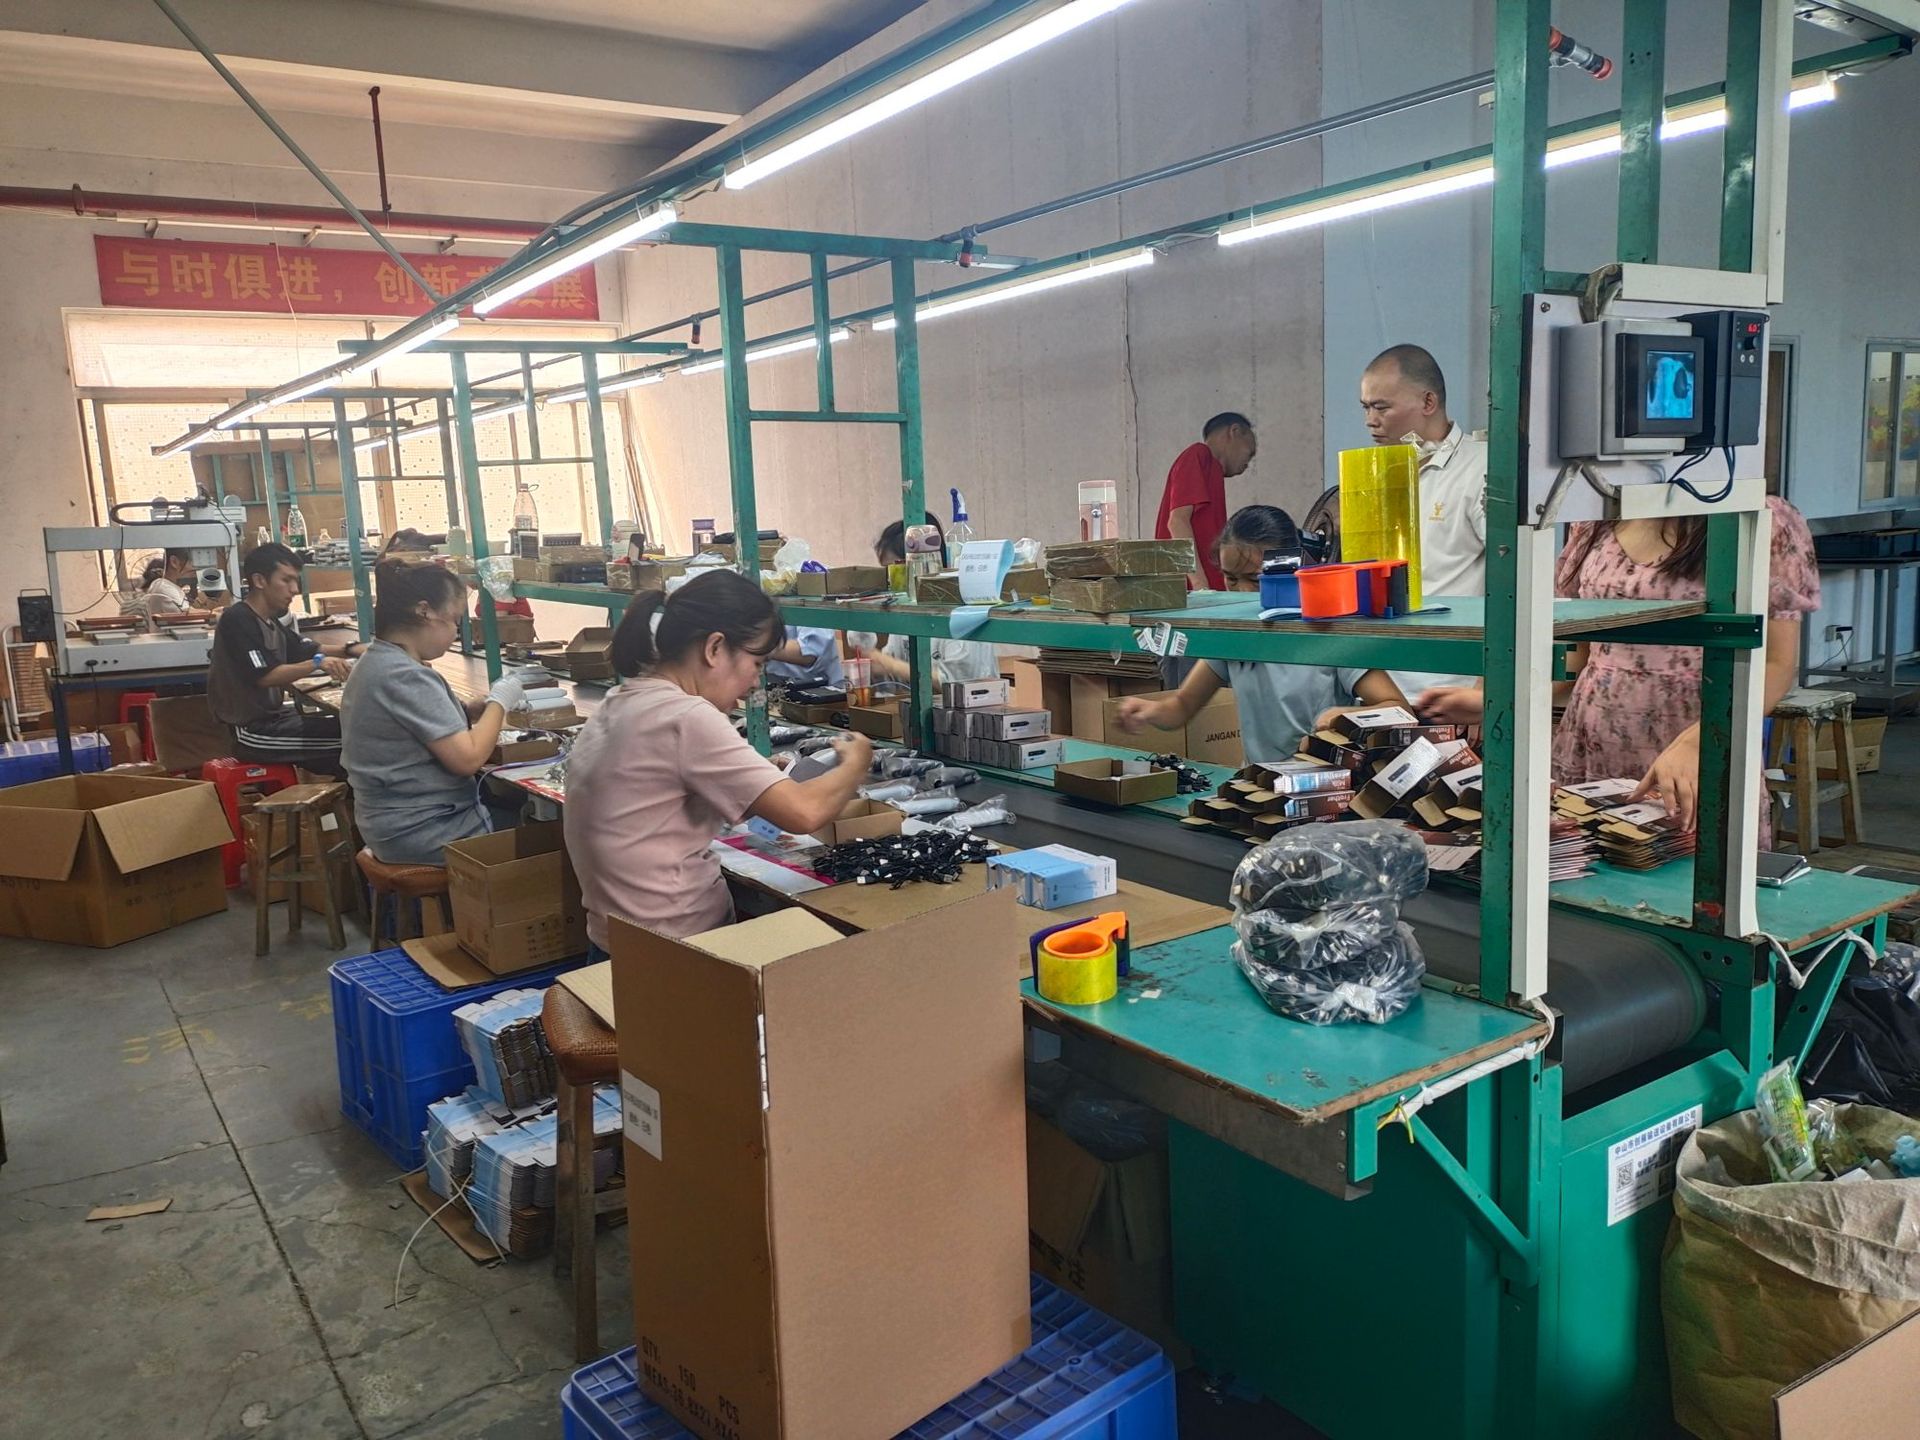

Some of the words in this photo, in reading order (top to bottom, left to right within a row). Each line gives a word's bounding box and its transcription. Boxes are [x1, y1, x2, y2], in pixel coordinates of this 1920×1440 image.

[115, 250, 585, 311] 与时俱进，创新展
